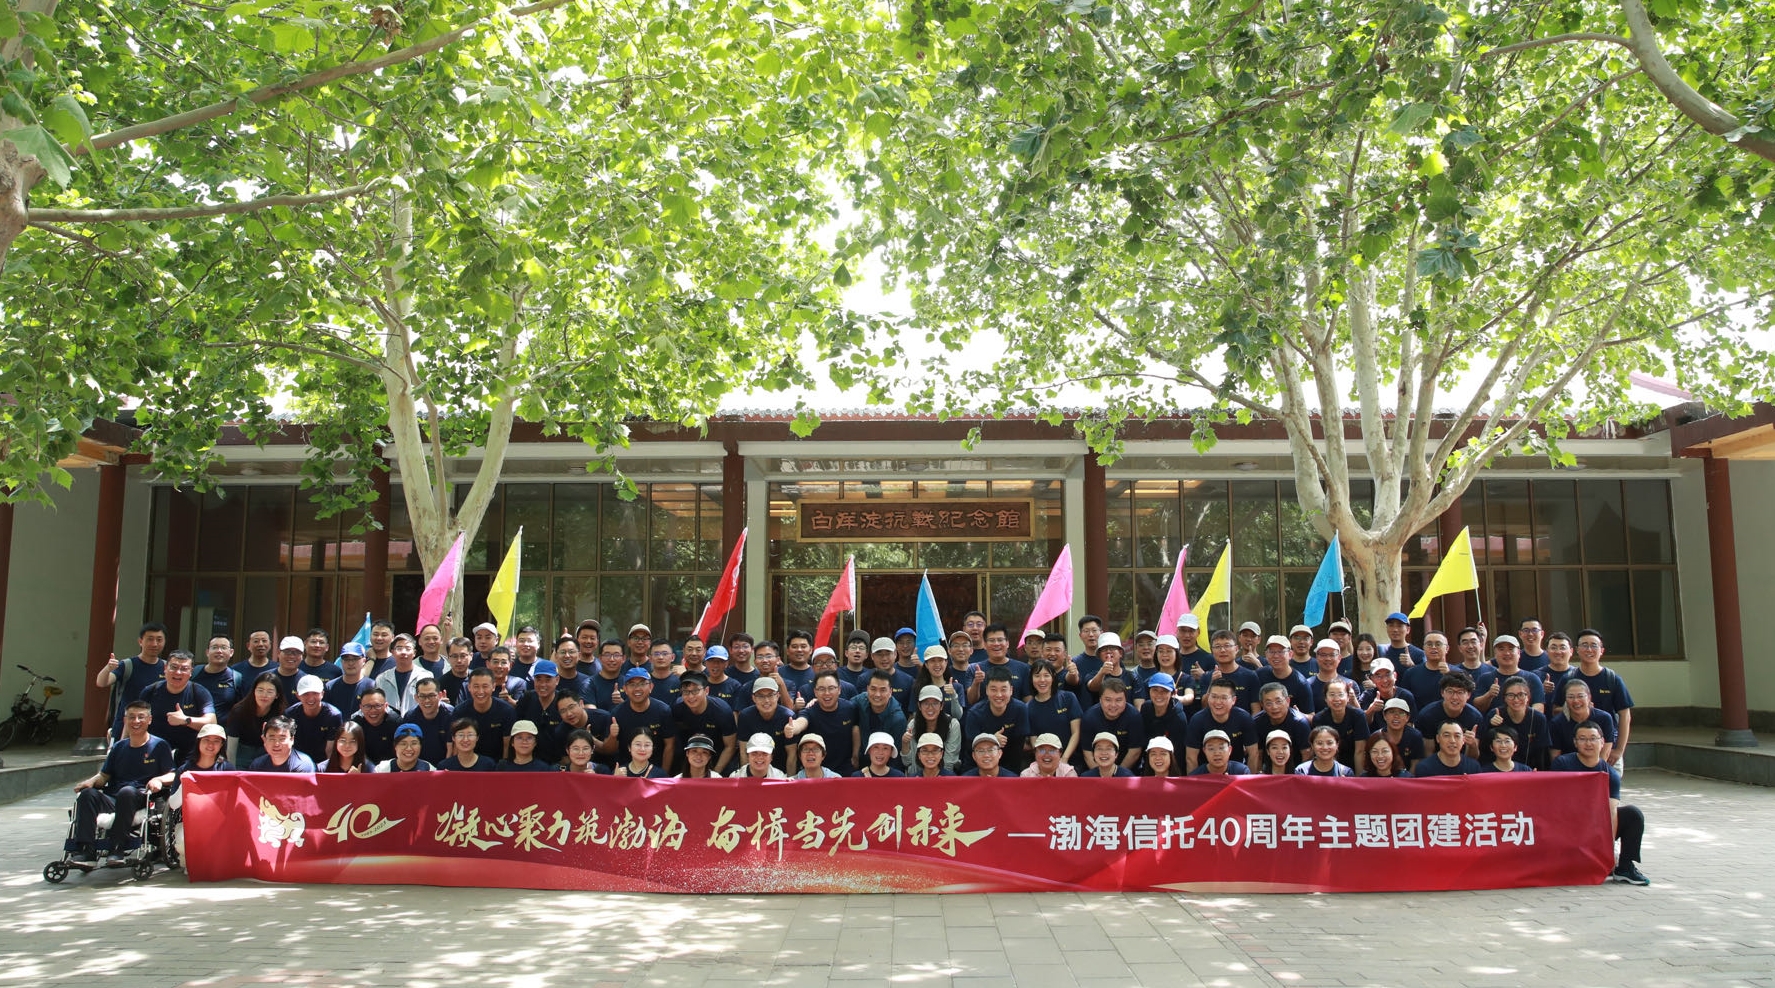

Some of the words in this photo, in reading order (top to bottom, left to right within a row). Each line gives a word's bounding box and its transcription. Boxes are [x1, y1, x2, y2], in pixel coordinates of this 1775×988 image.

[322, 803, 406, 843] 40
[435, 802, 688, 852] 凝心聚力筑渤海
[706, 802, 996, 861] 奋楫当先创未来
